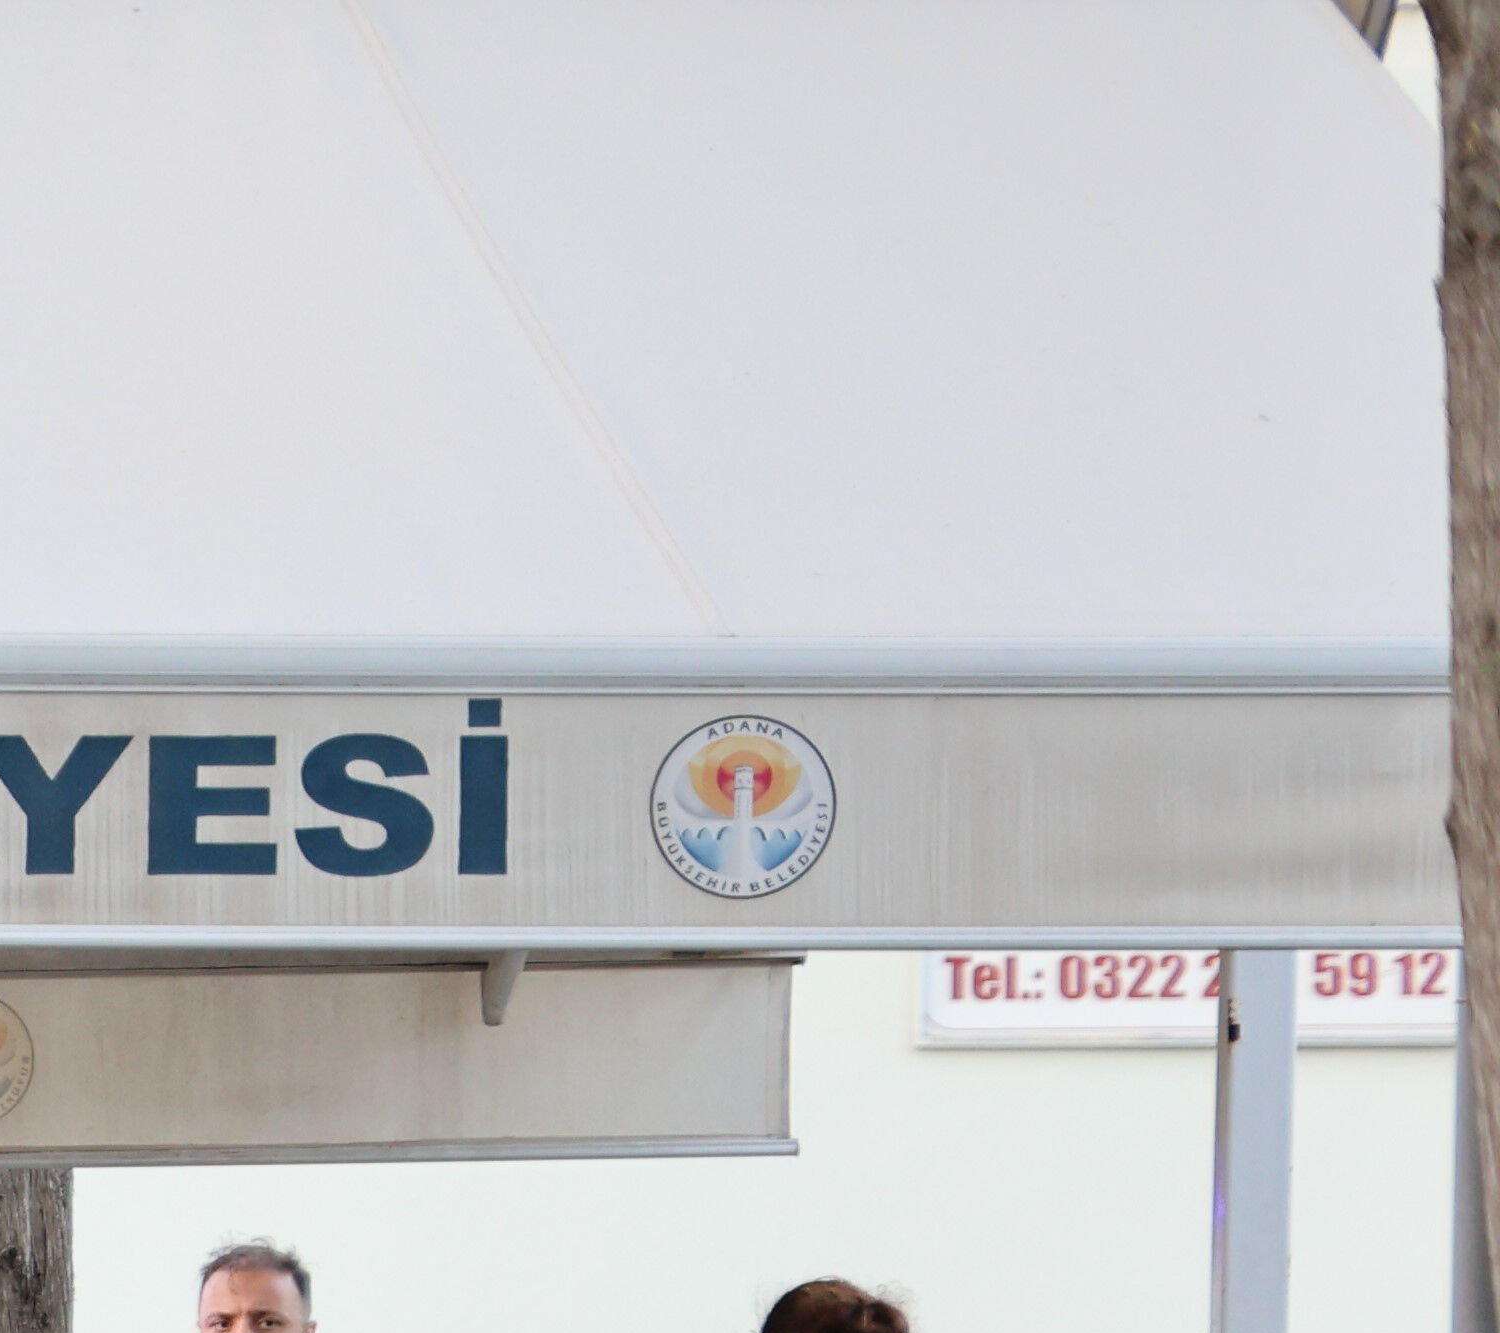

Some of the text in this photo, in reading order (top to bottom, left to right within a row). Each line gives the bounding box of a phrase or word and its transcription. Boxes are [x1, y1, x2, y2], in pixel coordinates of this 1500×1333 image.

[706, 720, 785, 740] ADANA
[1058, 953, 1188, 1001] 0322
[1312, 951, 1378, 997] 59
[1394, 951, 1449, 996] 12
